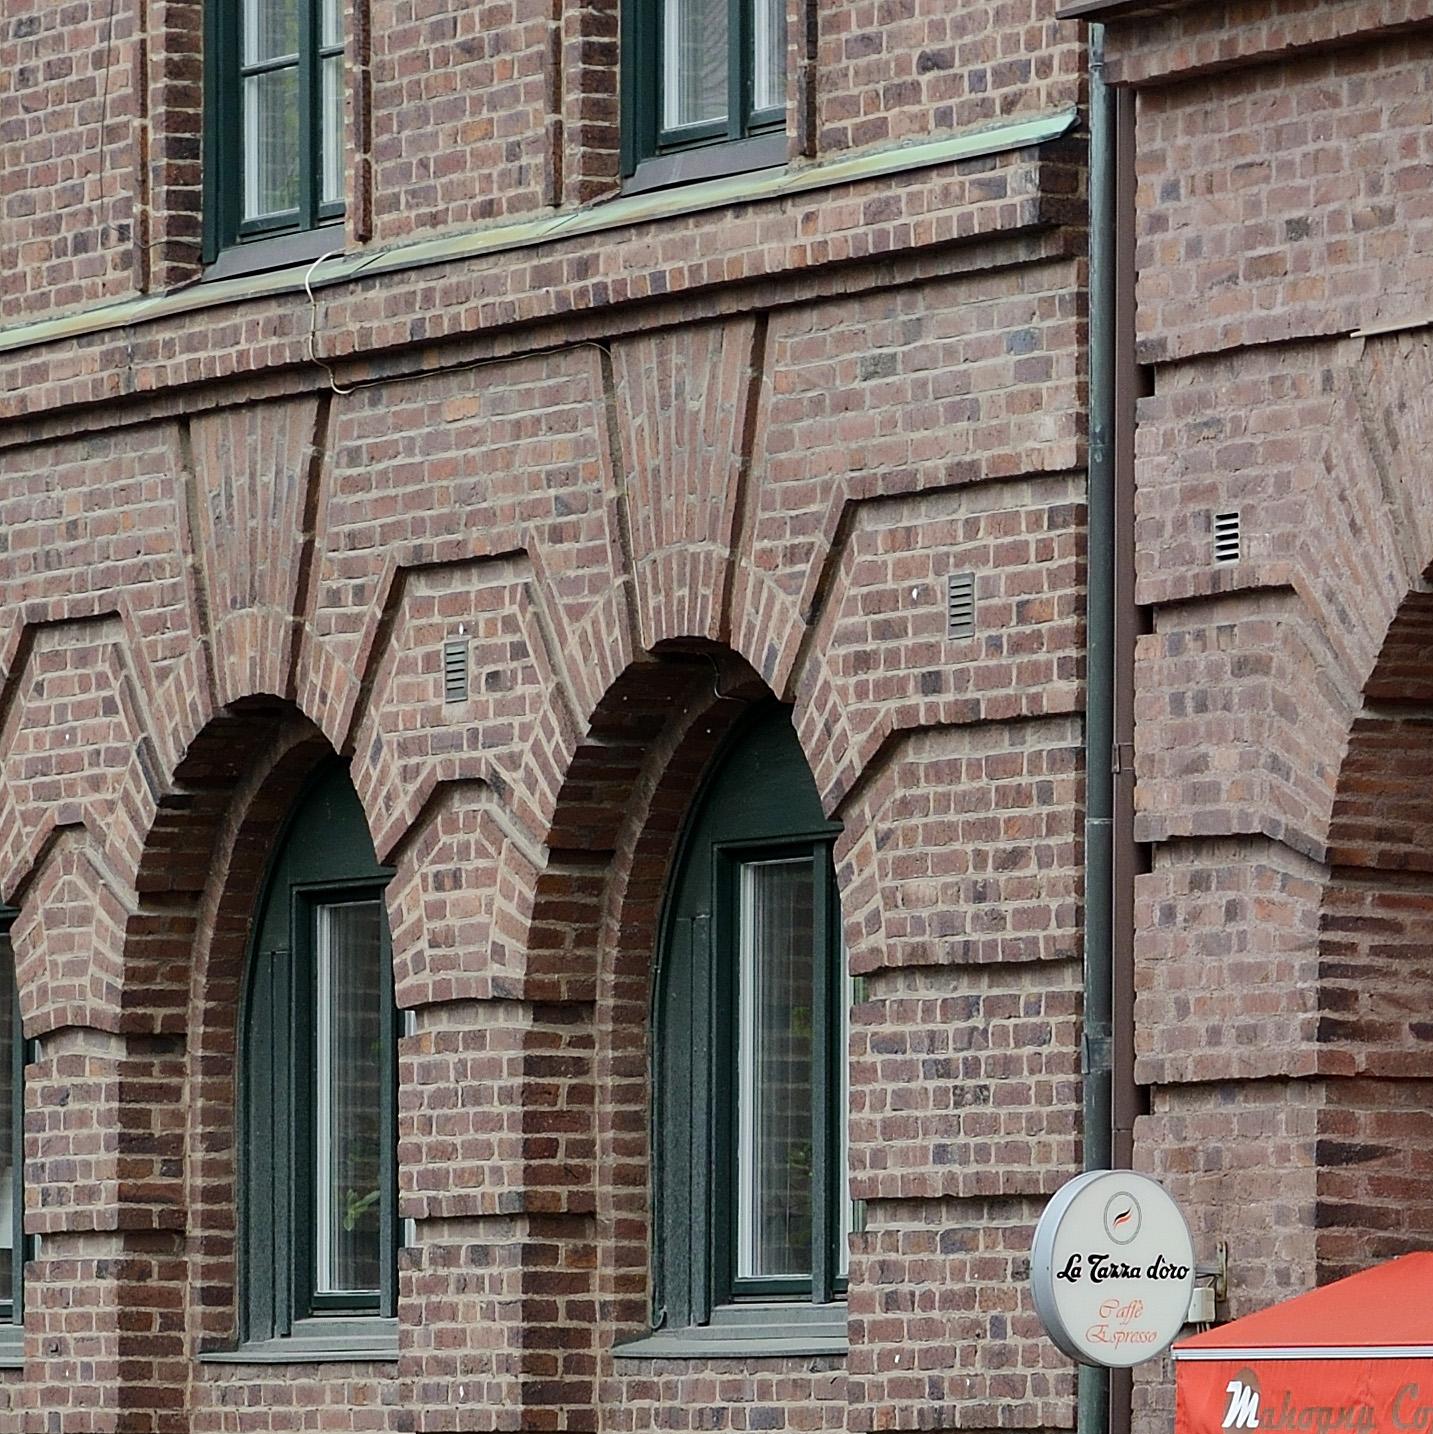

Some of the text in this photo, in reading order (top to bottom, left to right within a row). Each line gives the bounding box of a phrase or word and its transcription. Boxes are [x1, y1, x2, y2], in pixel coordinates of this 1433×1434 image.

[1057, 1254, 1081, 1282] La
[1087, 1254, 1140, 1283] Tazza
[1085, 1324, 1157, 1350] Espresso
